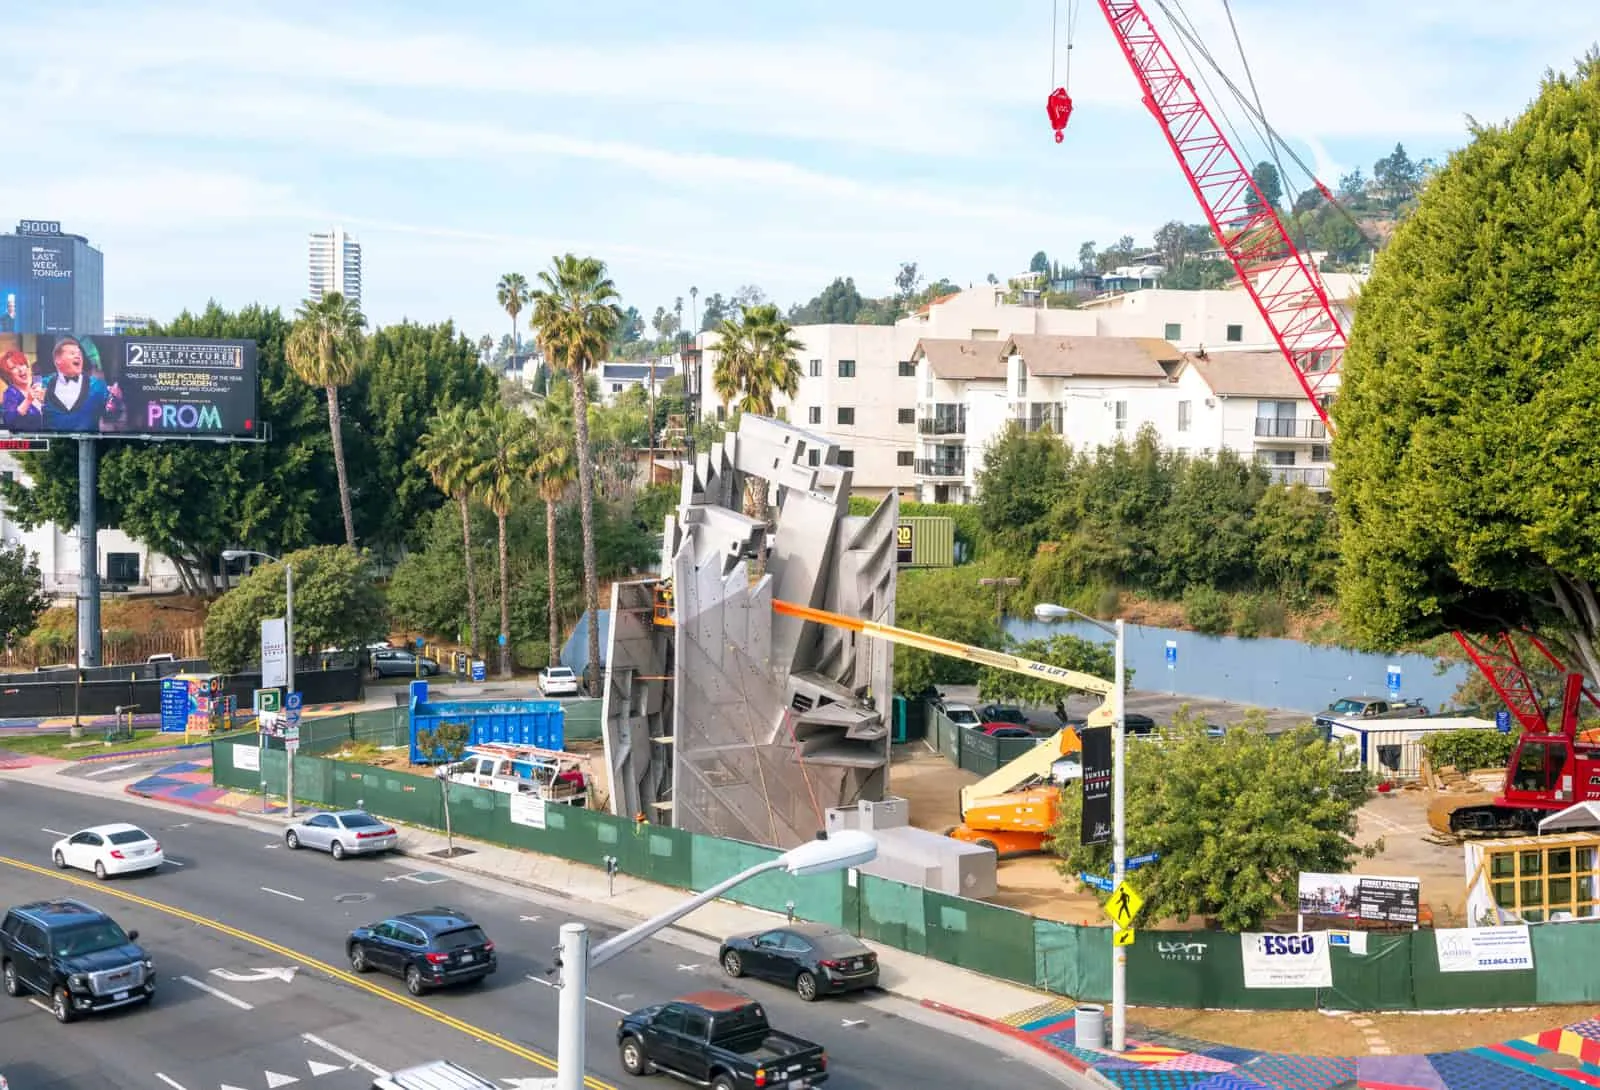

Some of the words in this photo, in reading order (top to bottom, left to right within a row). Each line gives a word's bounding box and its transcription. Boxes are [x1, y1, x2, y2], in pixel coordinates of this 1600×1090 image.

[22, 221, 59, 233] 9000
[32, 253, 55, 261] LAST
[32, 261, 57, 269] WEEK
[32, 269, 72, 278] TONIGHT
[129, 344, 144, 365] 2
[143, 351, 170, 359] BEST
[158, 372, 176, 380] BEST
[182, 379, 211, 387] CORDEN
[148, 404, 223, 429] PROM
[262, 695, 274, 711] P
[1085, 769, 1110, 779] SUNSET
[1085, 781, 1110, 791] STRIP
[1263, 934, 1315, 955] ESCO
